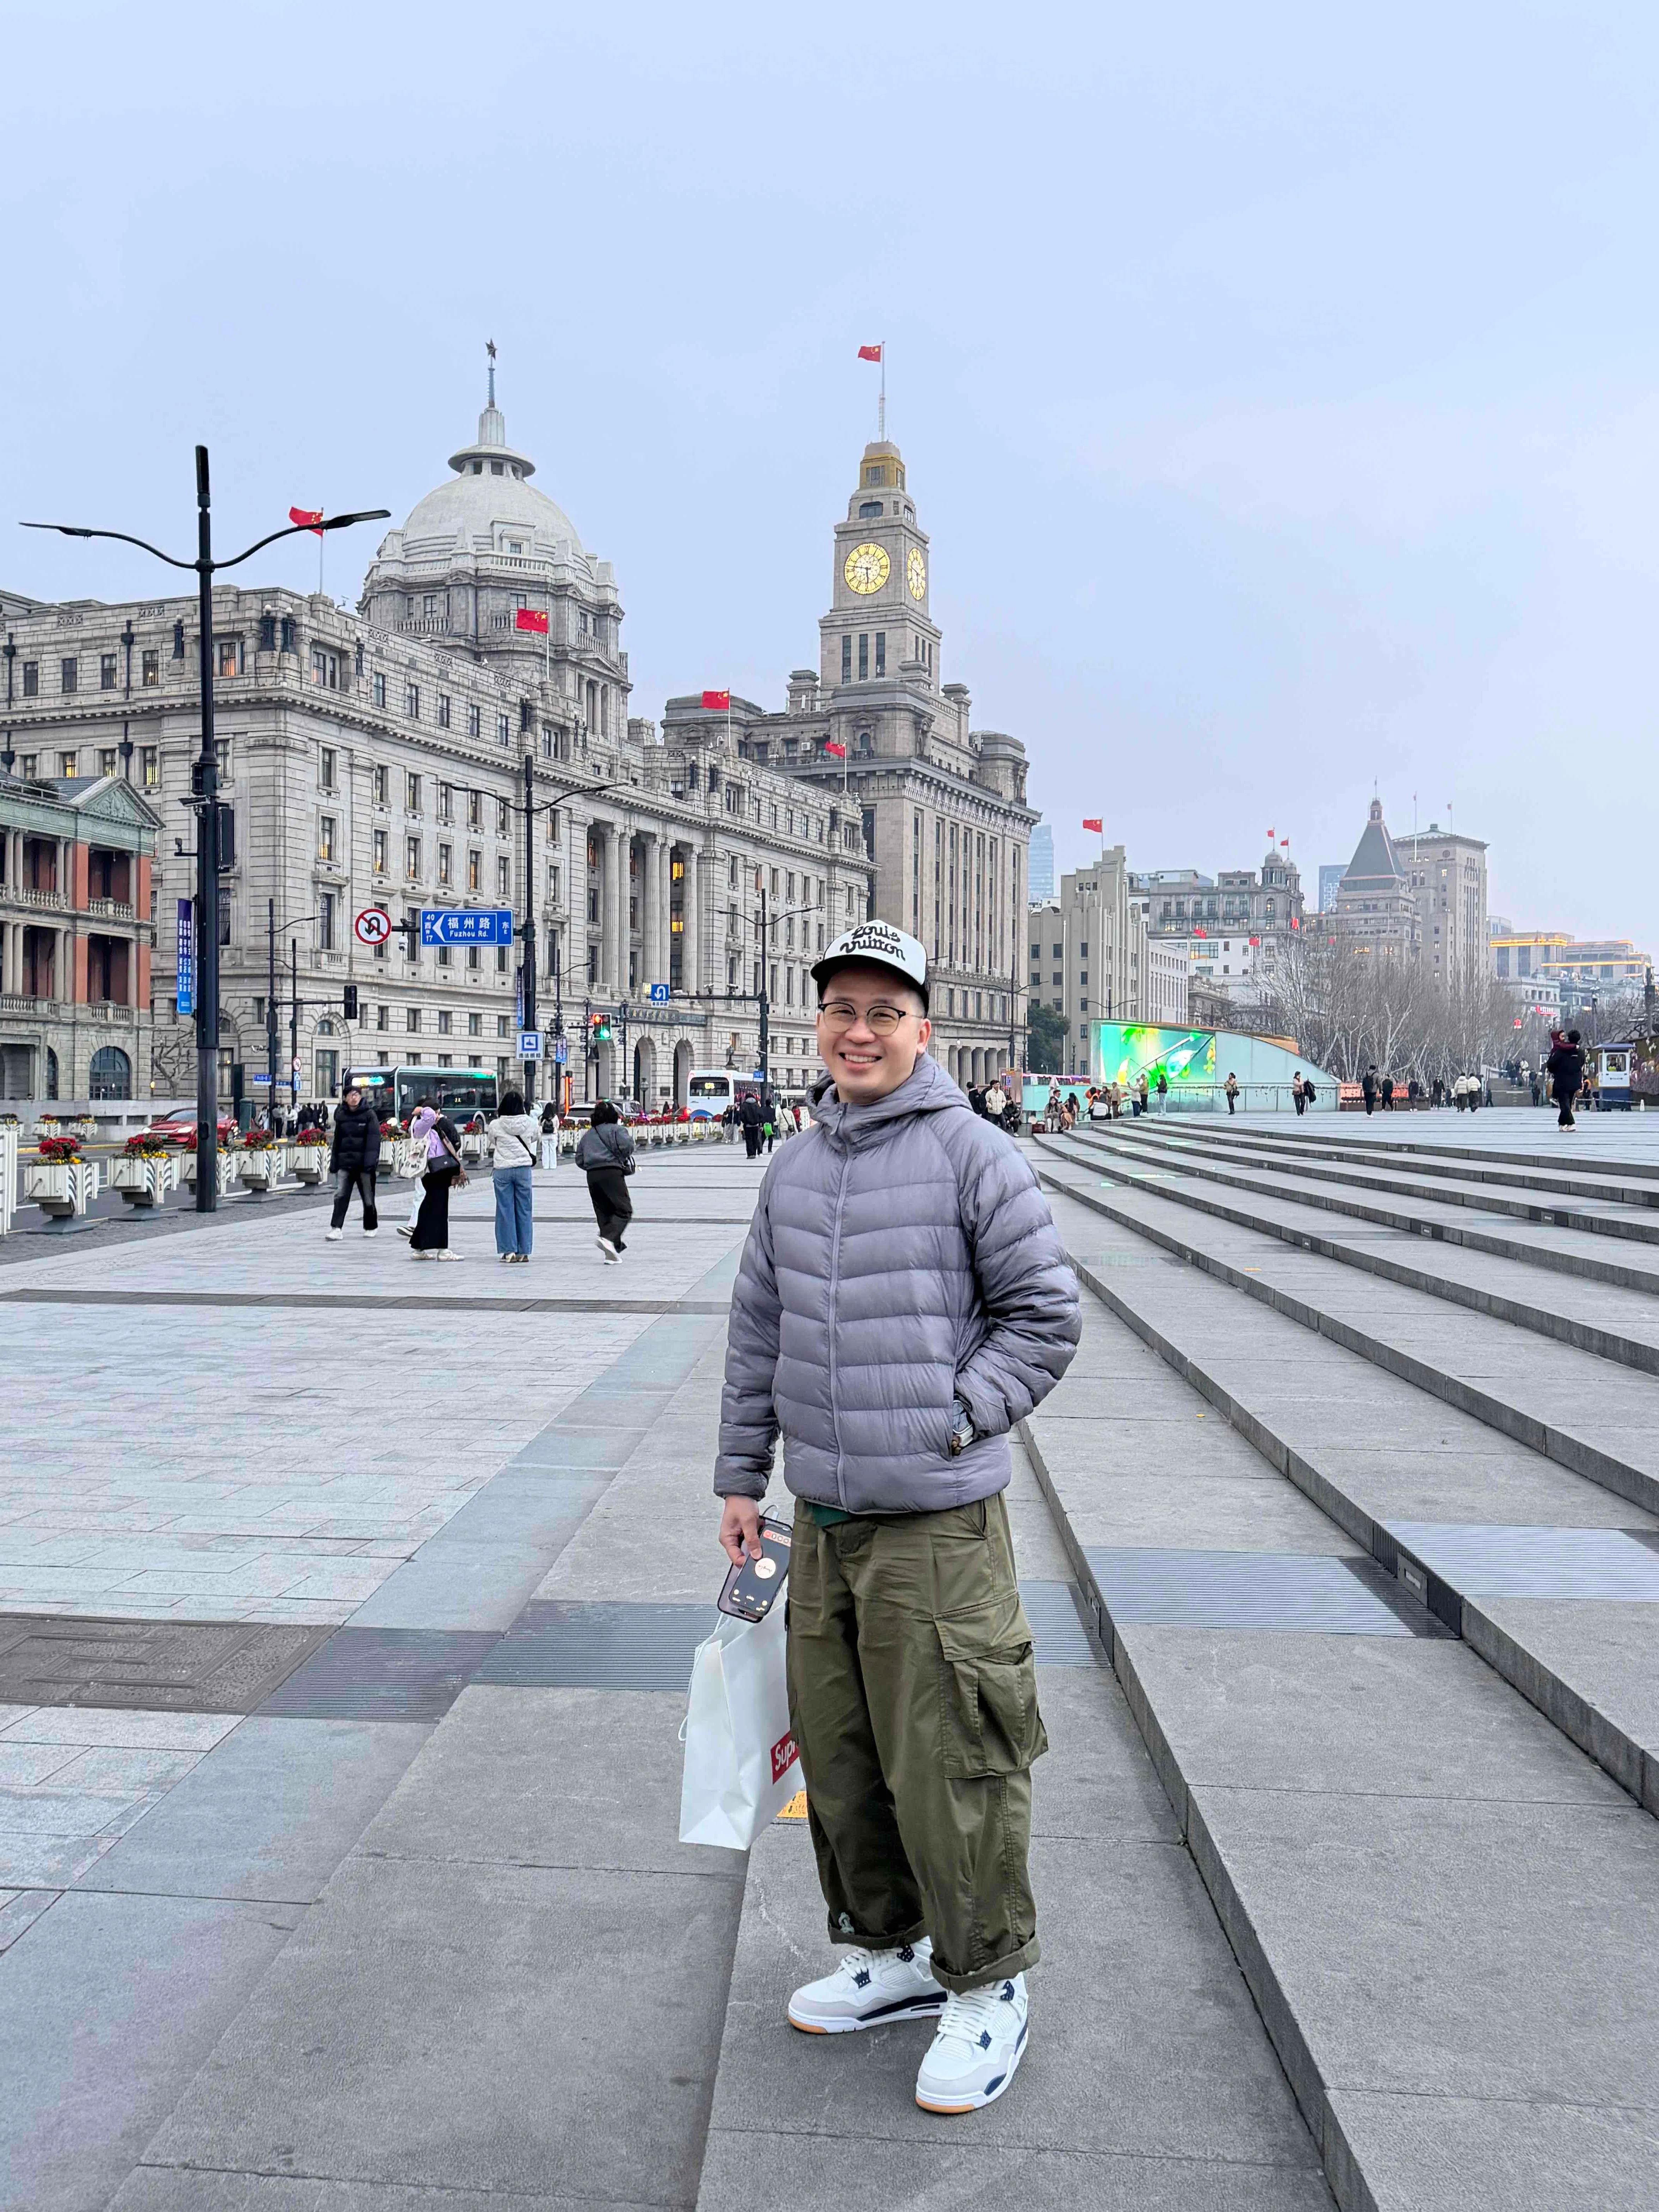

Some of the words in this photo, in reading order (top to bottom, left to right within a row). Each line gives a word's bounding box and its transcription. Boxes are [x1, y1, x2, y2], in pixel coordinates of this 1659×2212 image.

[448, 917, 490, 929] 福州路
[502, 921, 510, 929] 东
[851, 926, 901, 943] Louis
